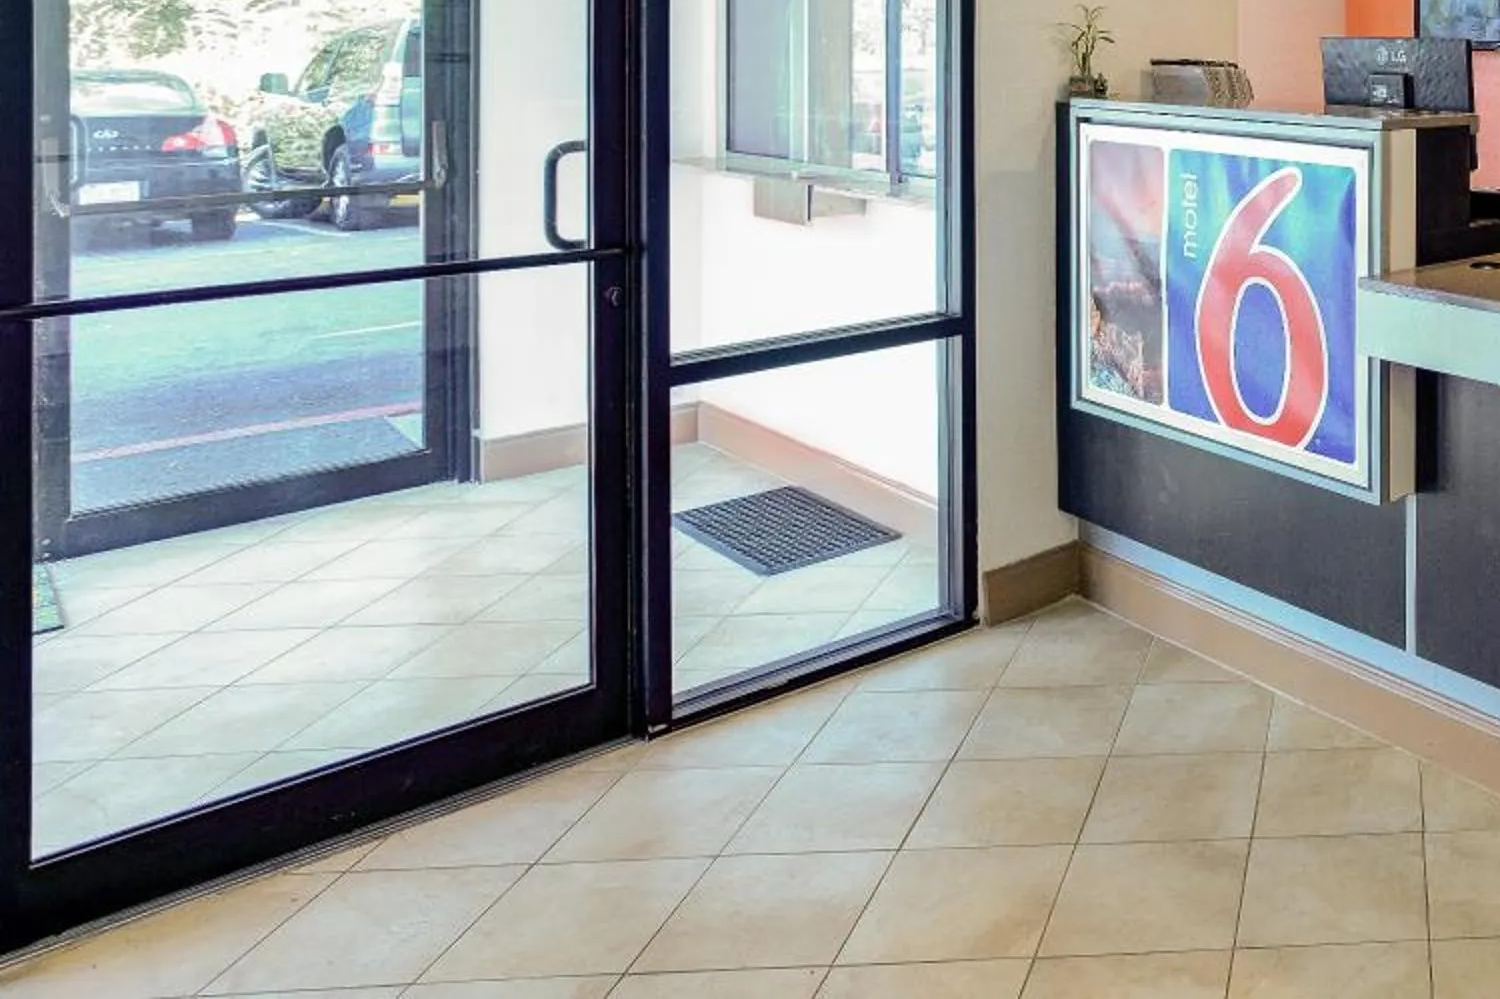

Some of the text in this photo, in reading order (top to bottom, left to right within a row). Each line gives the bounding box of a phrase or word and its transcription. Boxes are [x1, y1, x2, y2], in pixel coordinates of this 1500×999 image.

[1390, 49, 1407, 63] LG
[1179, 166, 1329, 451] motel 6
